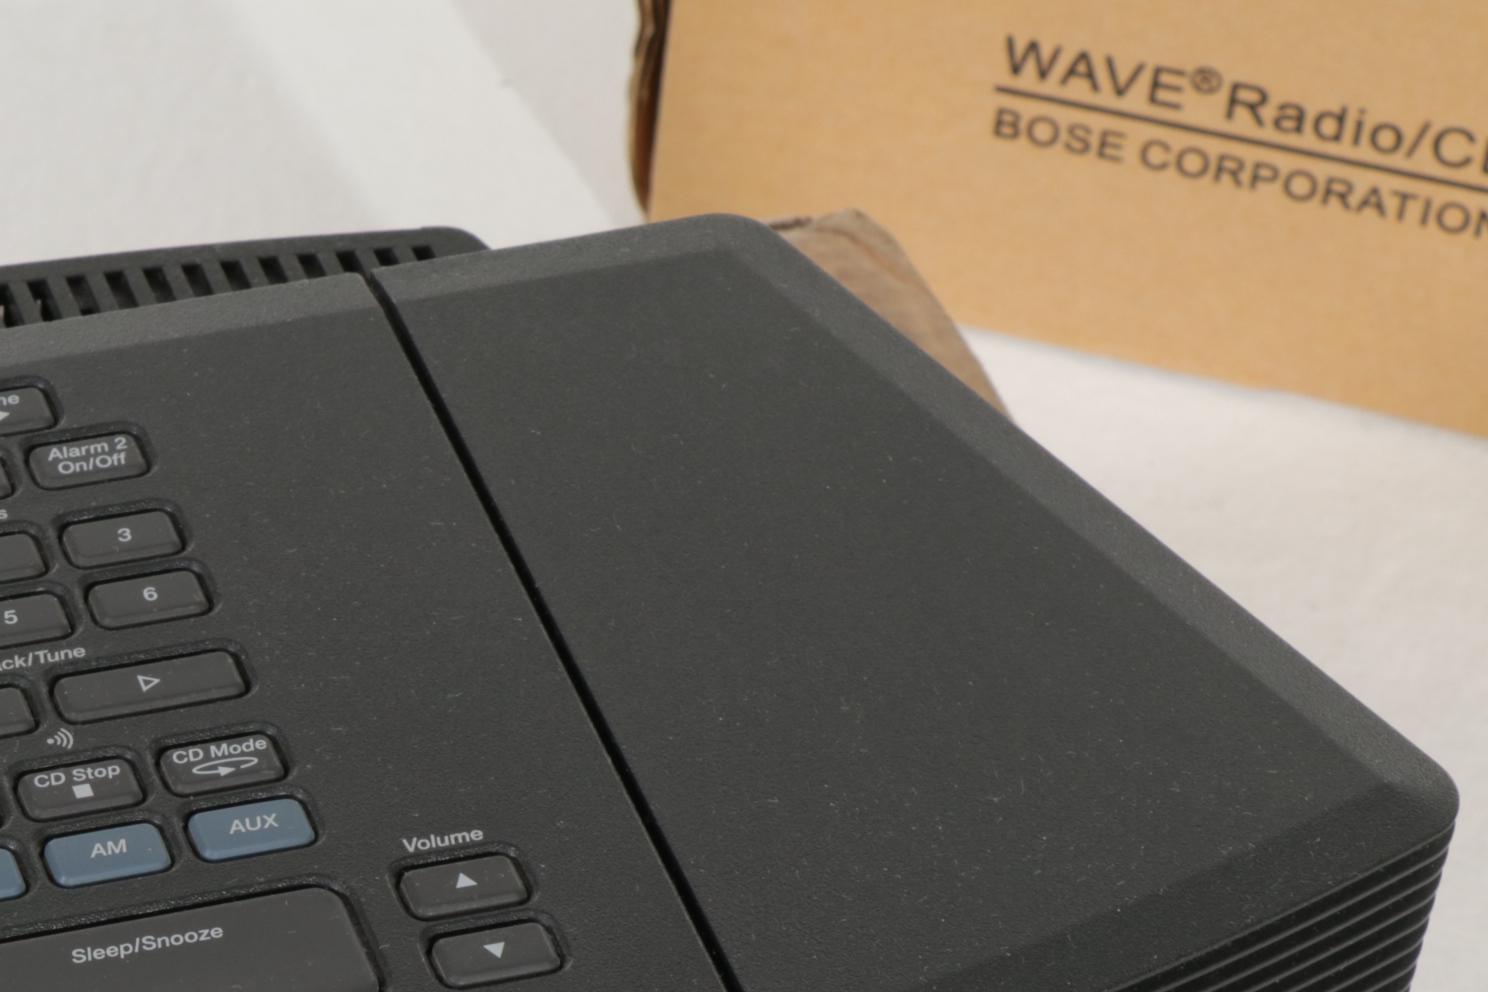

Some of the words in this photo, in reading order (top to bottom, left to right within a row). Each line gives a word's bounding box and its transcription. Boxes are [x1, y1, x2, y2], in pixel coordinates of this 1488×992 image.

[992, 106, 1128, 163] BOSE
[1225, 80, 1488, 176] Radio/C
[48, 440, 108, 461] Alarm
[114, 437, 127, 450] 2
[58, 453, 127, 475] On/Off
[117, 527, 132, 542] 3
[143, 586, 158, 601] 6
[3, 610, 18, 625] 5
[172, 747, 204, 765] CD
[209, 736, 267, 759] Mode
[33, 771, 67, 788] CD
[72, 763, 121, 783] Stop
[230, 813, 279, 835] AUX
[90, 839, 127, 858] AM
[403, 828, 484, 853] Volume
[71, 923, 225, 966] Sleep/Snooze
